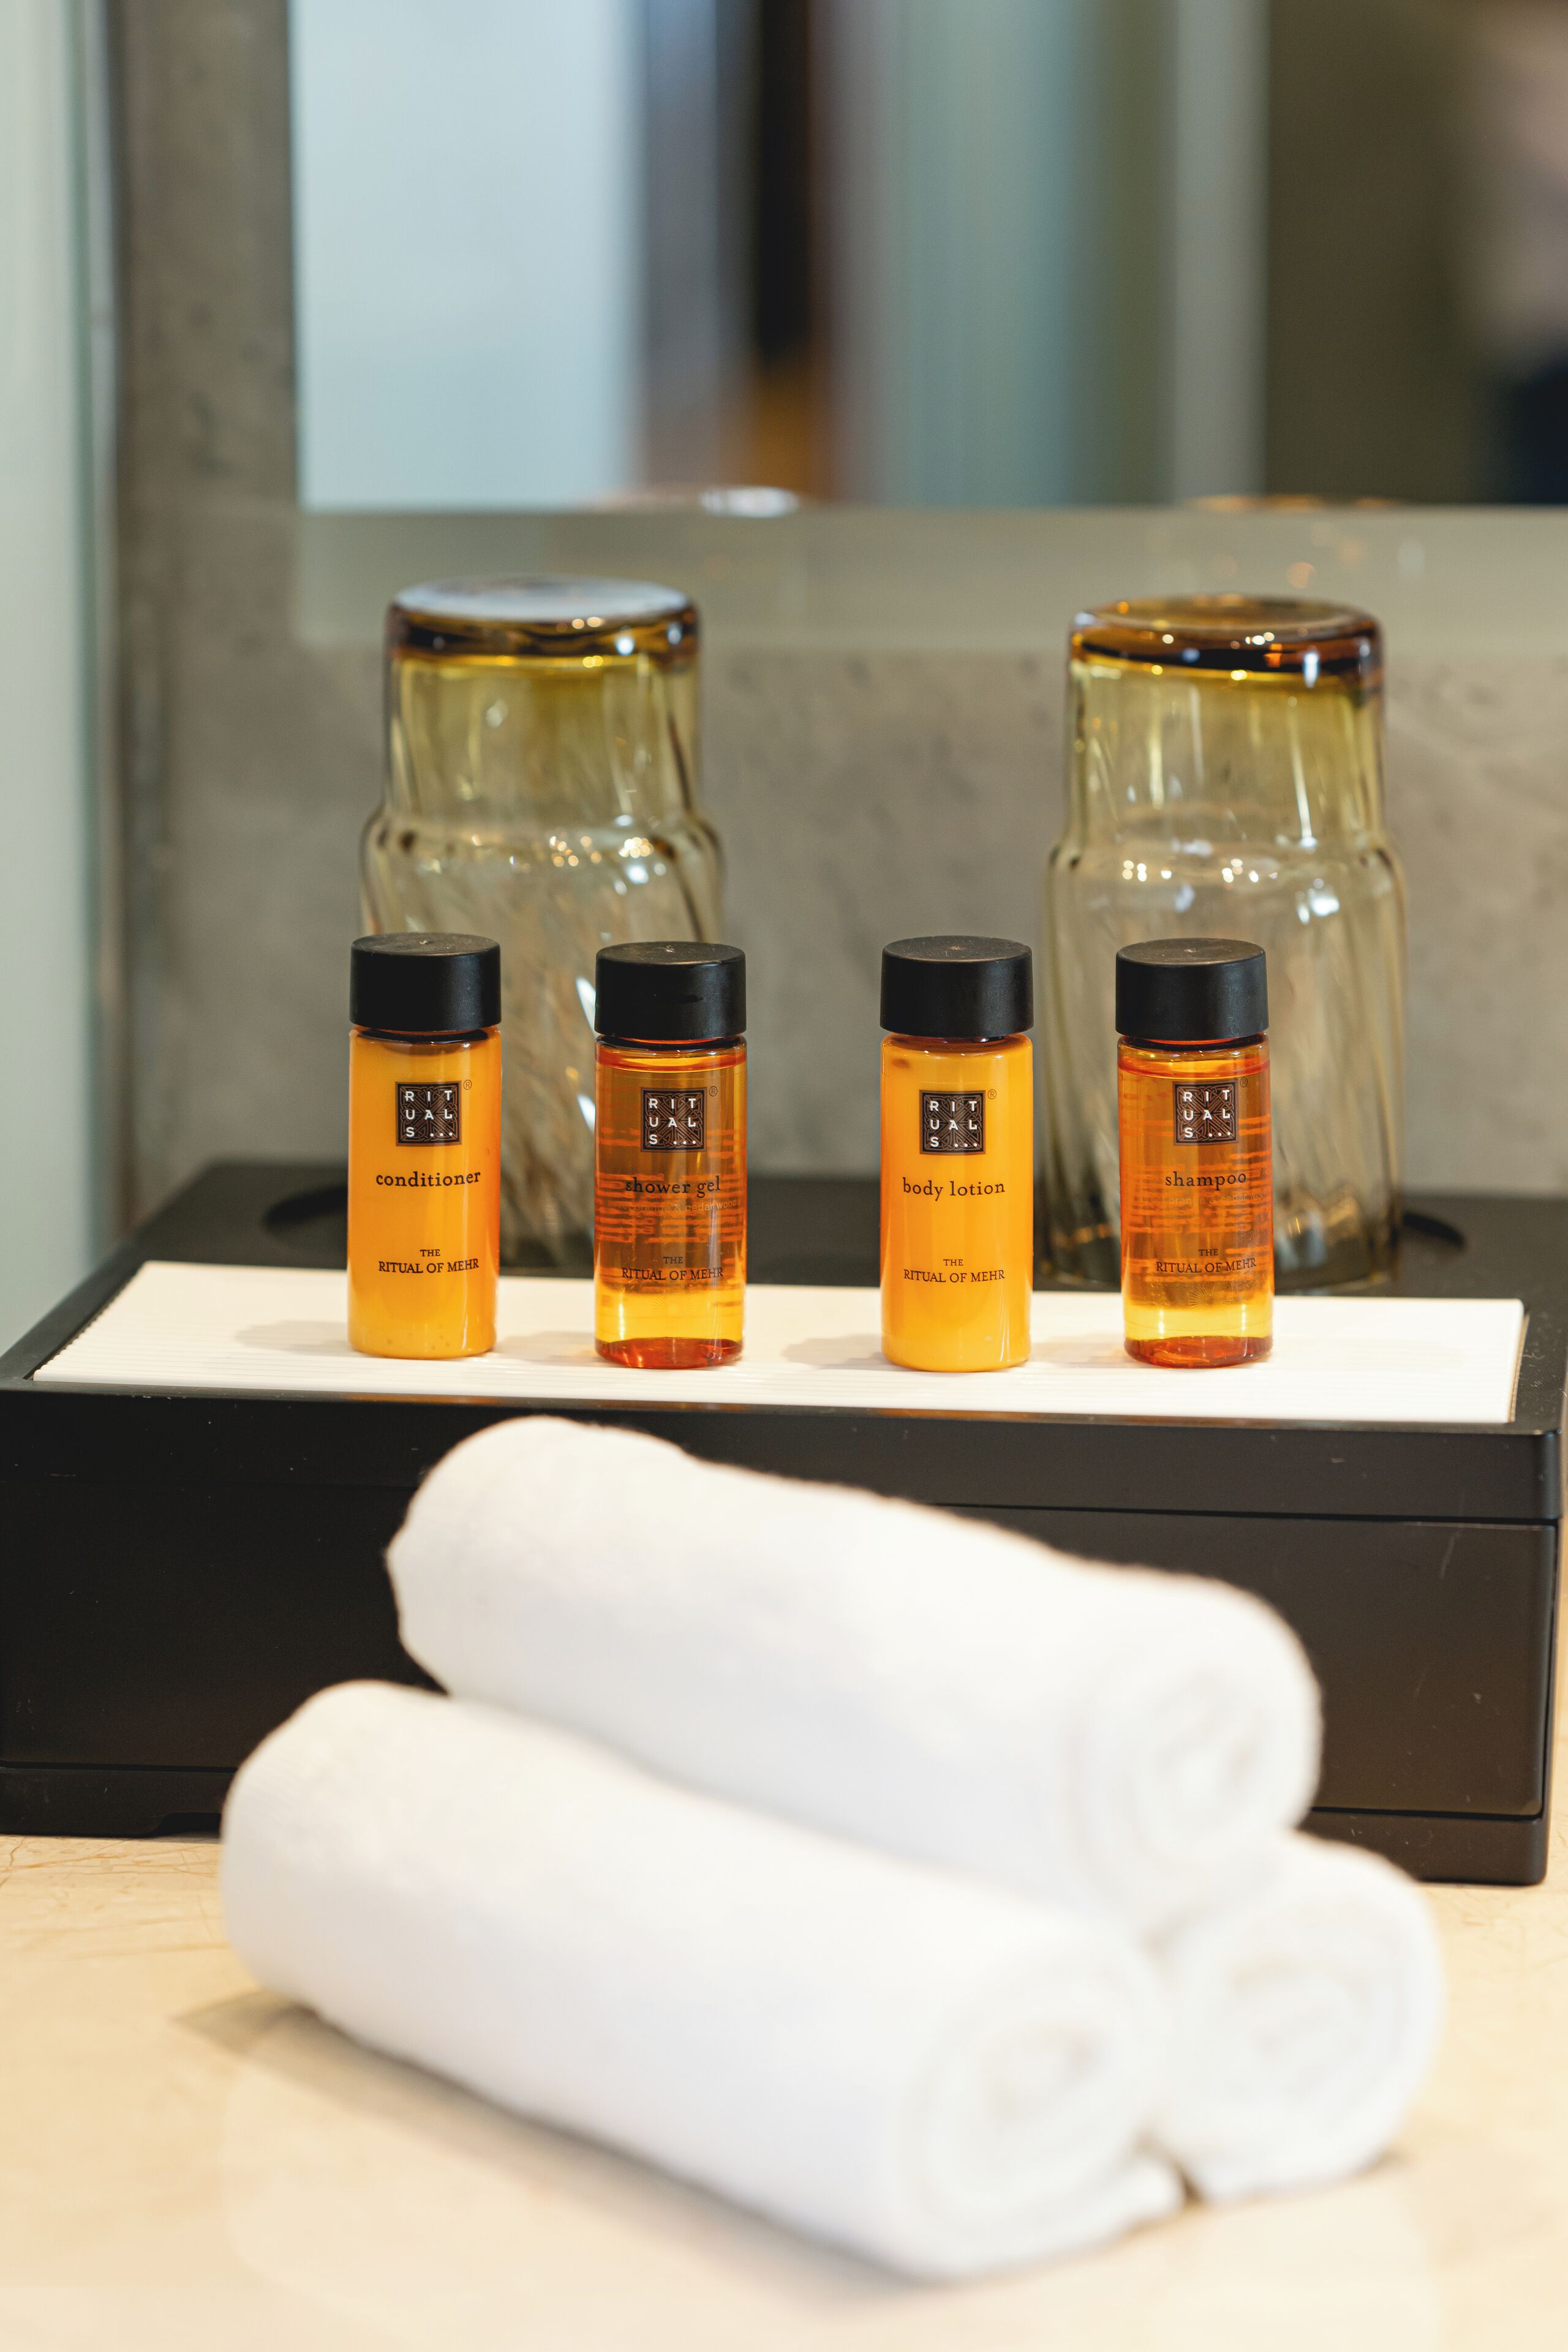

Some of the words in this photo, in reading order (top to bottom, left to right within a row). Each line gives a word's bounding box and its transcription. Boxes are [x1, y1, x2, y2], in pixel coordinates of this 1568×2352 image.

[376, 1171, 480, 1186] conditioner
[1166, 1171, 1246, 1191] shampoo
[625, 1177, 691, 1193] shower
[696, 1176, 721, 1197] gel
[903, 1177, 943, 1201] body
[950, 1181, 1005, 1196] lotion
[379, 1261, 423, 1273] RITUAL
[426, 1263, 443, 1273] OF
[448, 1259, 479, 1272] MEHR
[1156, 1262, 1201, 1273] RITUAL
[1205, 1262, 1222, 1273] OF
[1226, 1257, 1256, 1271] MEHR
[622, 1267, 666, 1280] RITUAL
[669, 1271, 687, 1280] OF
[691, 1267, 723, 1280] MEHR
[904, 1269, 946, 1282] RITUAL
[950, 1273, 967, 1283] OF
[971, 1270, 1005, 1282] MEHR
